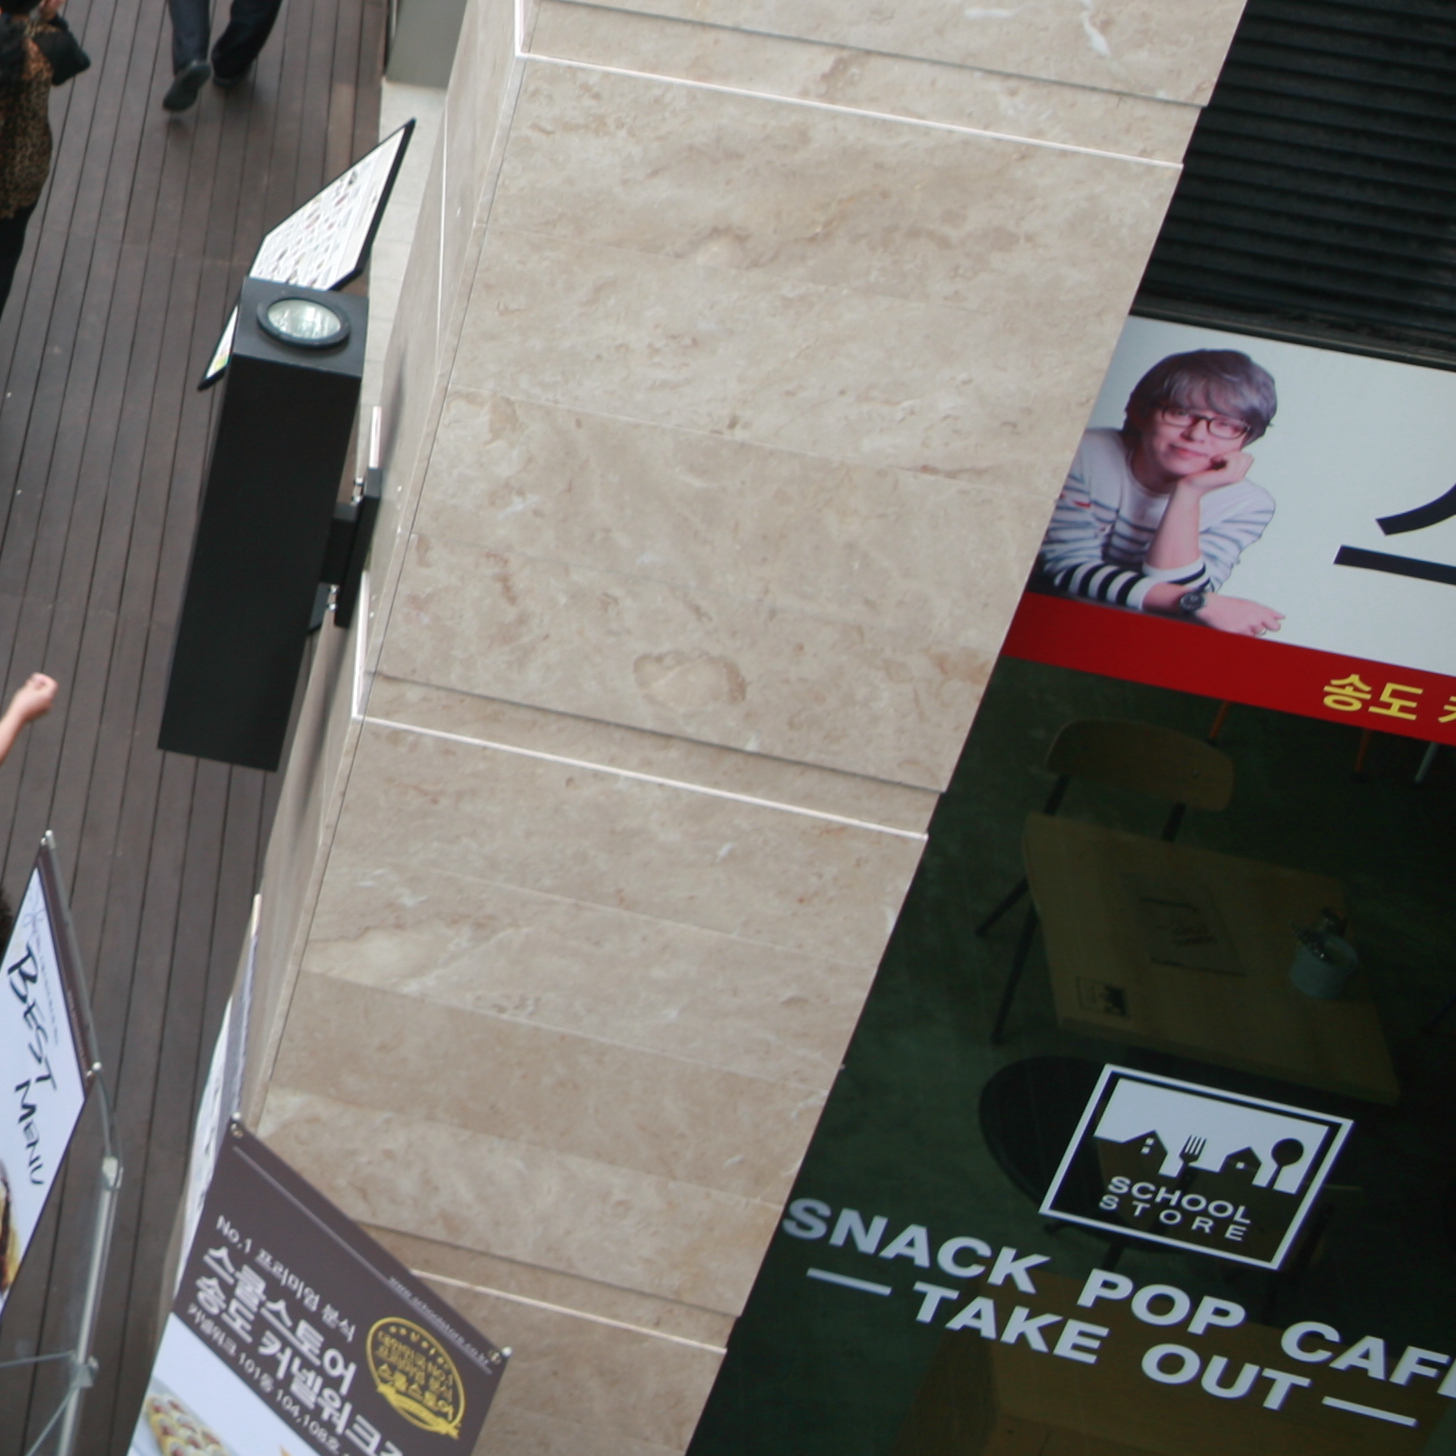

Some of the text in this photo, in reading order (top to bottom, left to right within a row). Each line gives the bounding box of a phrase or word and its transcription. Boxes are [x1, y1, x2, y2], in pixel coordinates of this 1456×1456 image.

[1323, 673, 1423, 721] 송도
[7, 942, 58, 1091] BEST
[13, 1078, 45, 1186] MENU
[1098, 1194, 1248, 1242] STORE
[1107, 1175, 1252, 1225] SCHOOL
[195, 1276, 255, 1344] 송도
[202, 1246, 357, 1396] 스쿨스토어
[216, 1214, 356, 1343] No.1 프리미엄 분식
[782, 1196, 1051, 1295] SNACK
[1076, 1268, 1247, 1337] POP
[913, 1281, 1311, 1411] TAKE OUT
